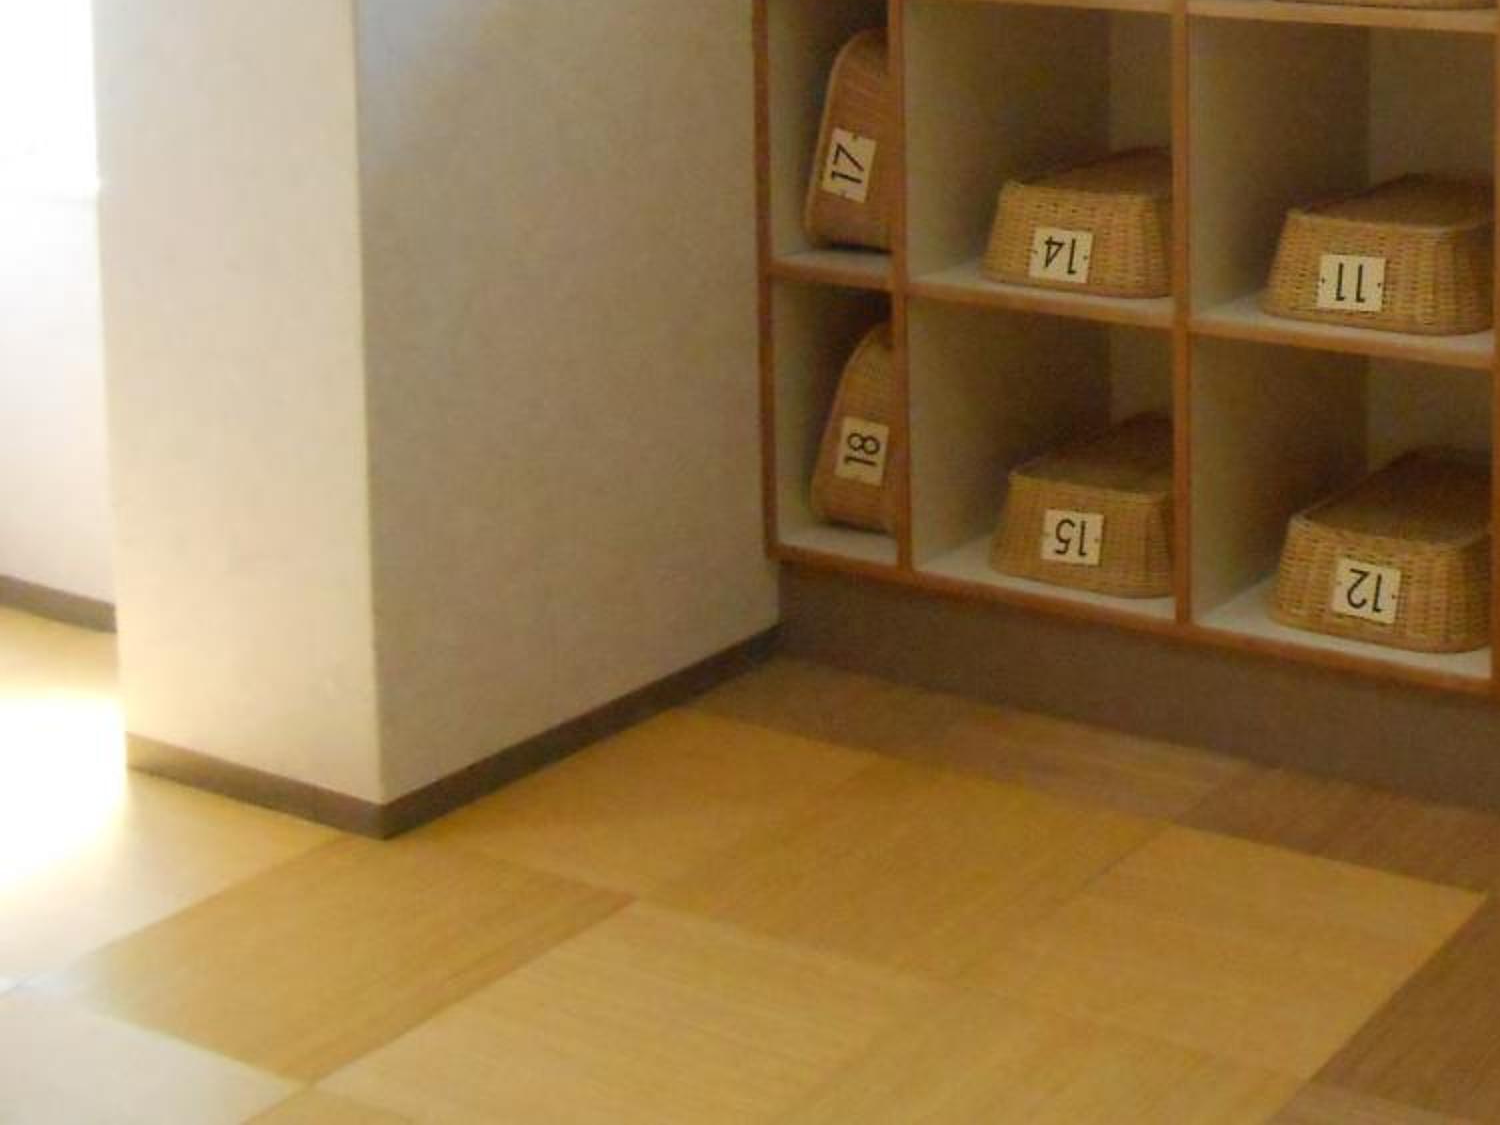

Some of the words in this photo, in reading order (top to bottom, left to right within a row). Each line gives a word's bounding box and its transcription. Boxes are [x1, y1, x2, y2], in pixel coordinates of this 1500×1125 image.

[831, 144, 865, 185] 17
[1044, 236, 1077, 274] 14
[1335, 262, 1365, 303] 11
[844, 432, 881, 467] 18
[1055, 519, 1087, 556] 15
[1347, 568, 1382, 613] 12
